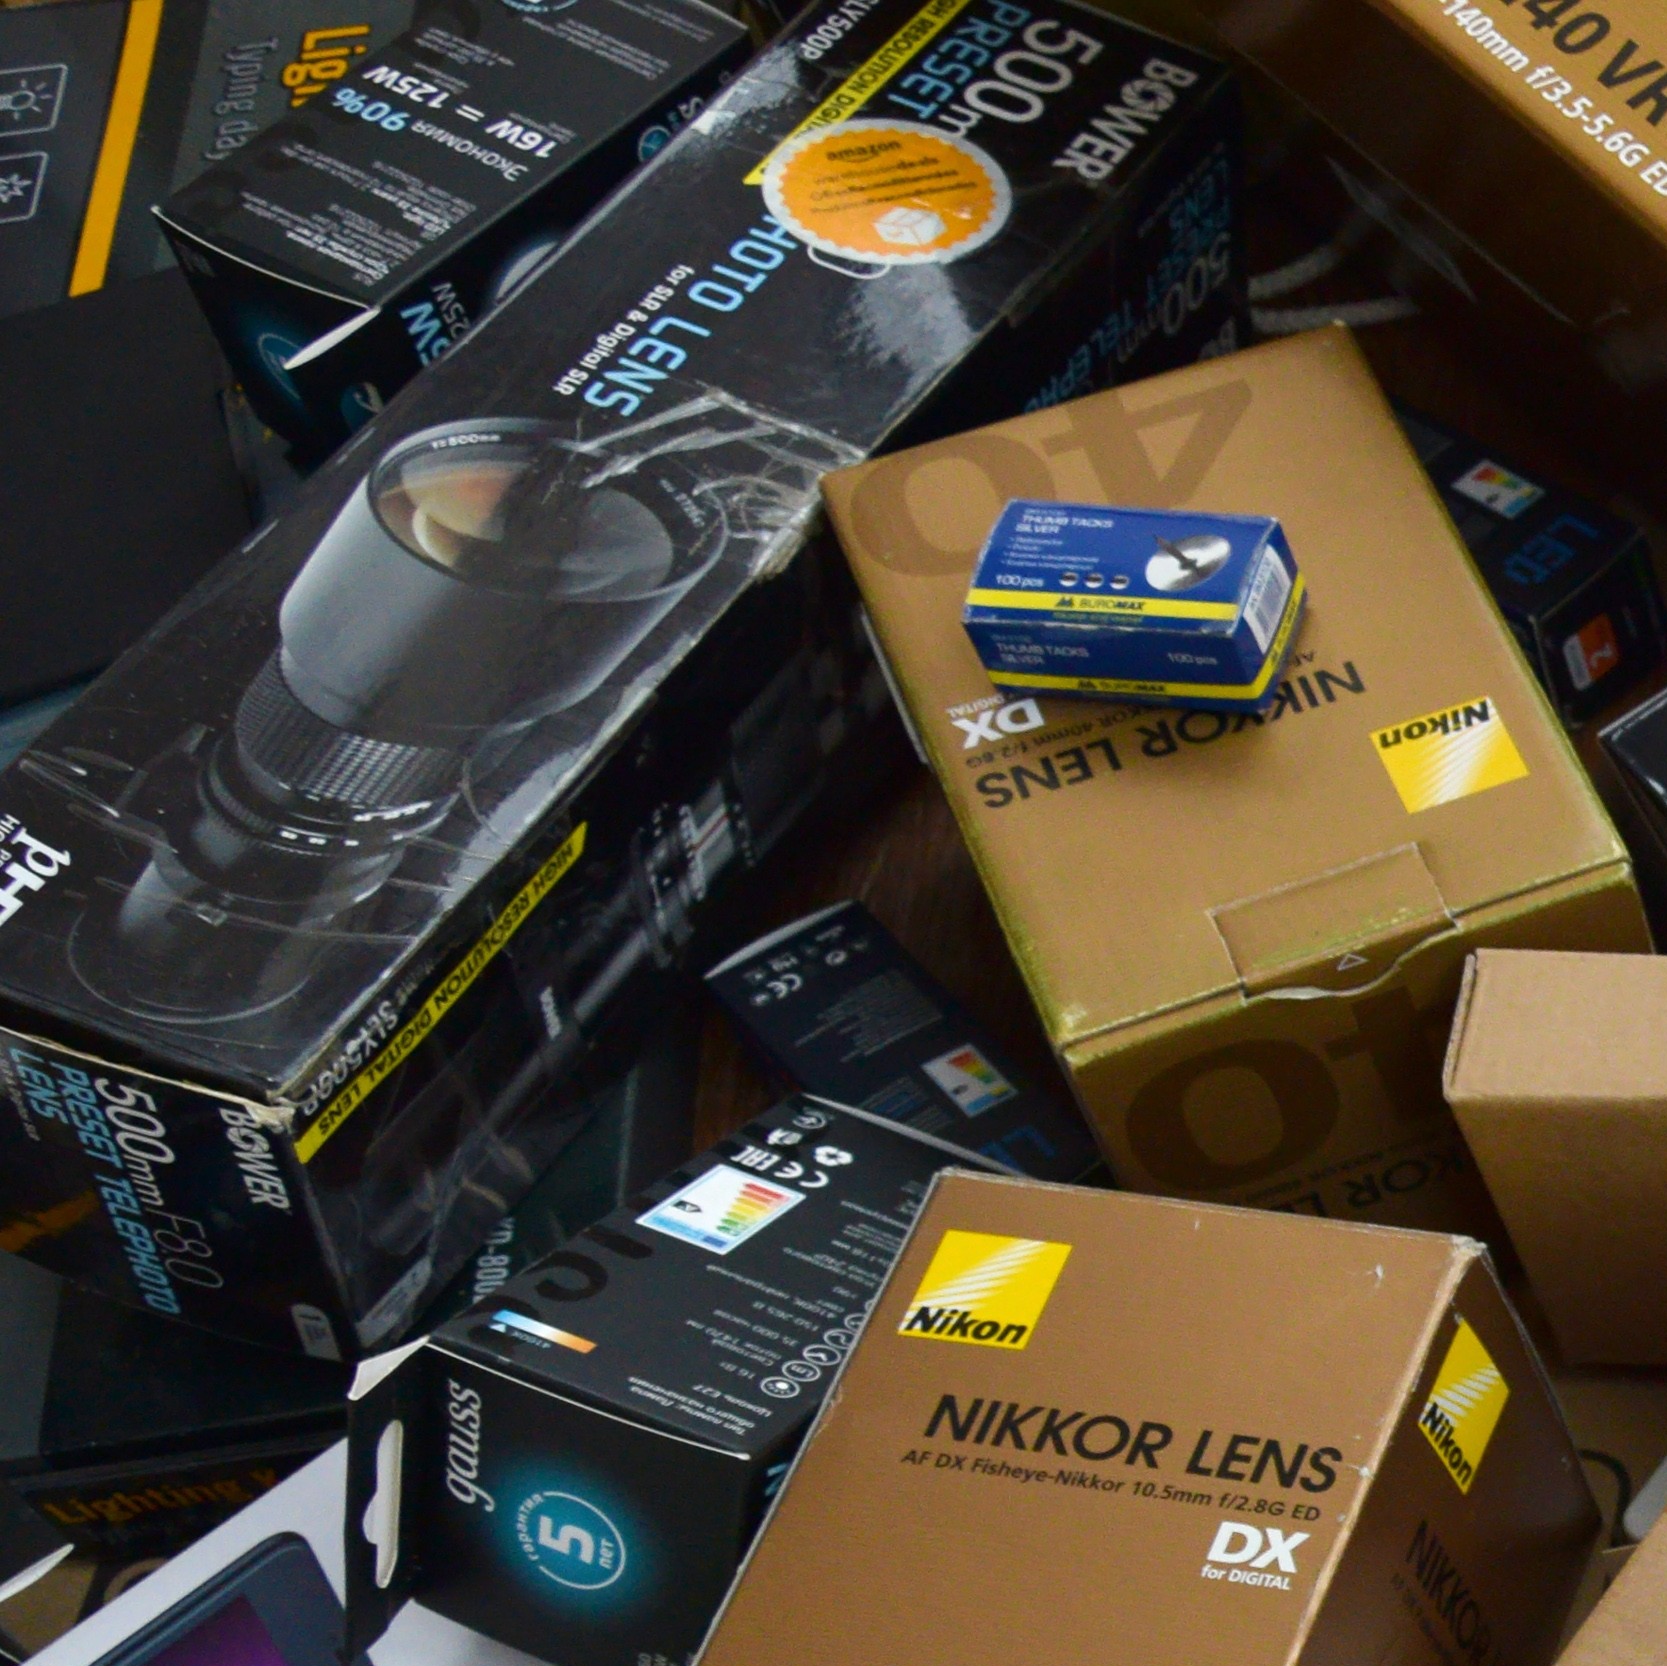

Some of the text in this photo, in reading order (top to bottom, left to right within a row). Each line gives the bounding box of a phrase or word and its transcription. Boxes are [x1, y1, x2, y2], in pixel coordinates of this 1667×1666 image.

[331, 87, 410, 132] 90%
[1052, 58, 1198, 181] BOWER
[1524, 65, 1651, 169] f/3.5-5.6G
[552, 263, 695, 395] for SLR & Digital SLR
[583, 215, 800, 418] HOTO LENS
[962, 698, 1046, 751] DX
[1377, 698, 1494, 750] Nikon
[974, 747, 1115, 809] LENS
[319, 844, 574, 1135] HIGH RESOLUTION DIGITAL LENS
[11, 1048, 69, 1124] LENS
[51, 1061, 181, 1314] PRESET TELEPHOTO
[95, 1078, 175, 1206] 500mm
[219, 1107, 292, 1212] BOWER
[902, 1305, 1029, 1346] Nikon
[446, 1379, 495, 1512] gauss
[899, 1448, 1321, 1522] AF DX Fisheye-Nikkor 10.5mm f/2.8G ED
[923, 1394, 1344, 1496] NIKKOR LENS
[1418, 1401, 1474, 1495] Nikon
[537, 1515, 595, 1564] 5
[1200, 1563, 1294, 1591] for DIGITAL
[1205, 1520, 1311, 1574] DX
